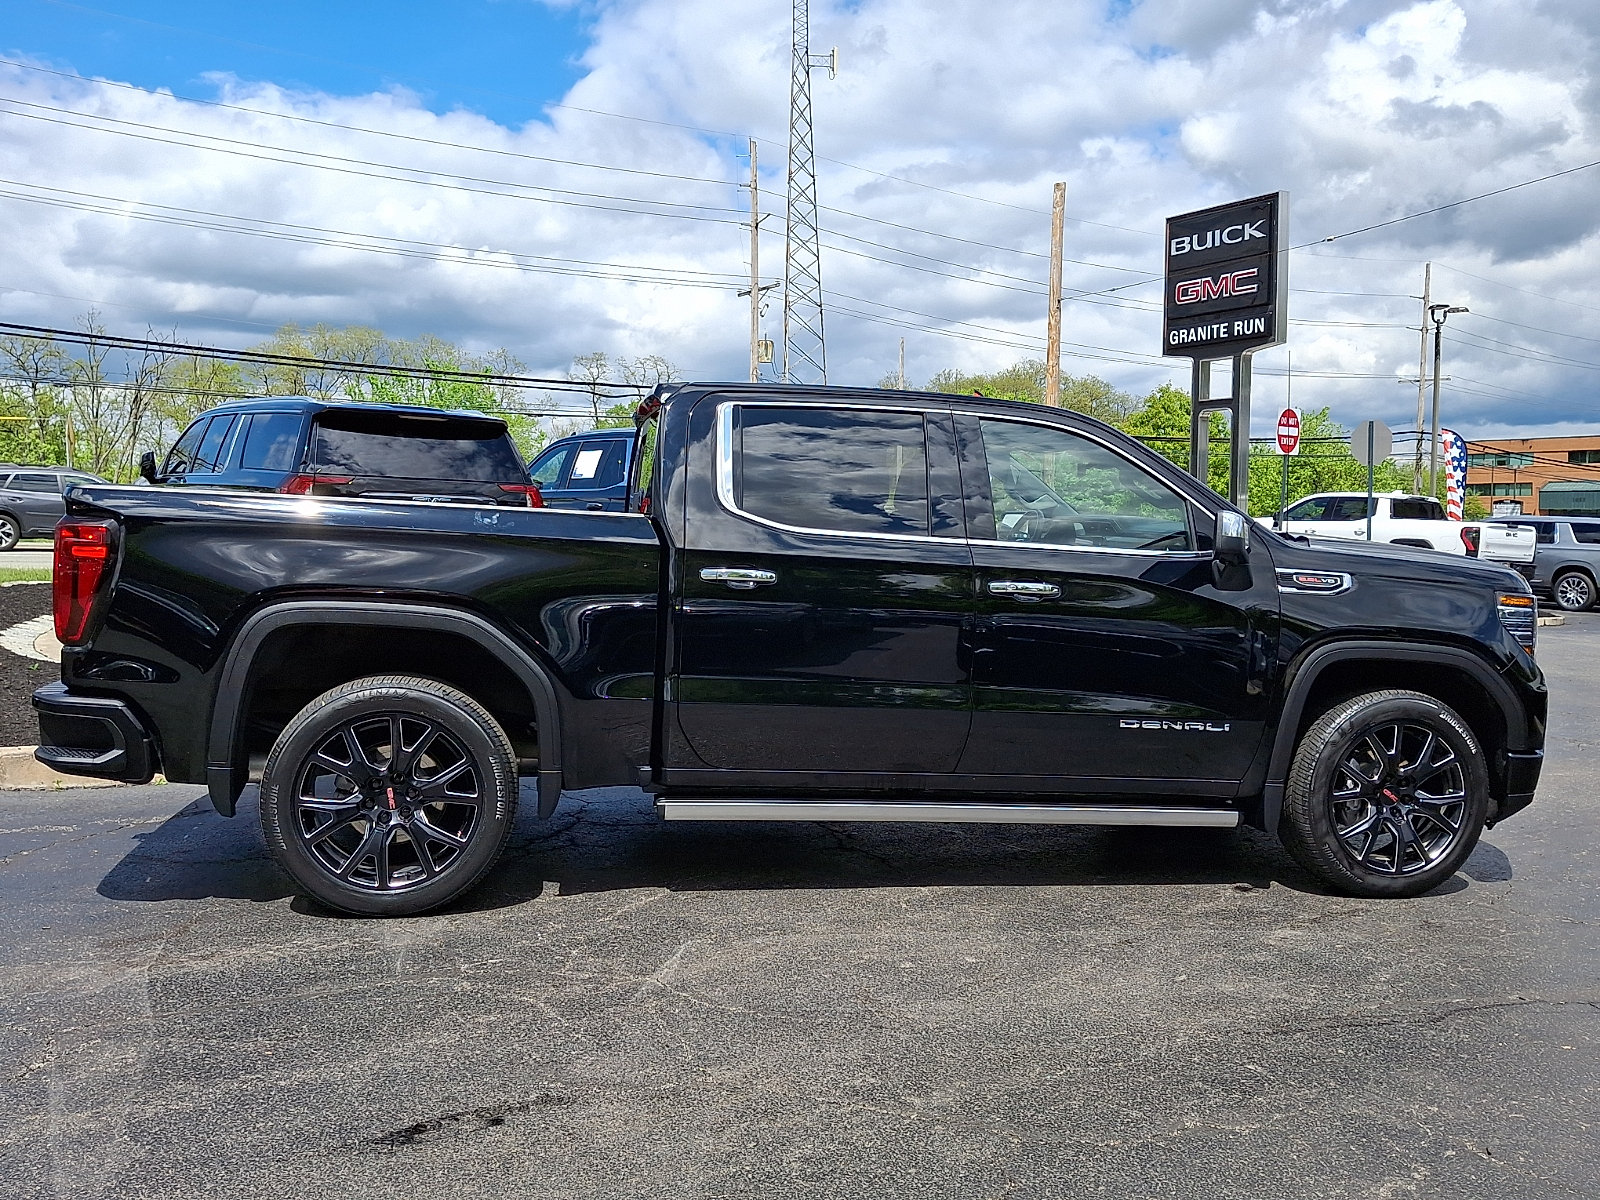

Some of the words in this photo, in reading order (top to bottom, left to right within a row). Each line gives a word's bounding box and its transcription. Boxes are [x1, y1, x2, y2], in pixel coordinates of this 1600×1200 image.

[1170, 219, 1267, 256] BUICK
[1175, 268, 1259, 305] GMC
[1169, 322, 1229, 345] GRANITE
[1233, 317, 1266, 337] RUN
[1280, 416, 1287, 424] DO
[1289, 417, 1297, 425] NOT
[1280, 437, 1294, 445] ENTER
[354, 689, 399, 700] ALENZA
[1119, 719, 1230, 732] DENALI
[1438, 710, 1478, 755] BRIDGESTONE
[488, 754, 506, 820] BRIDGESTONE
